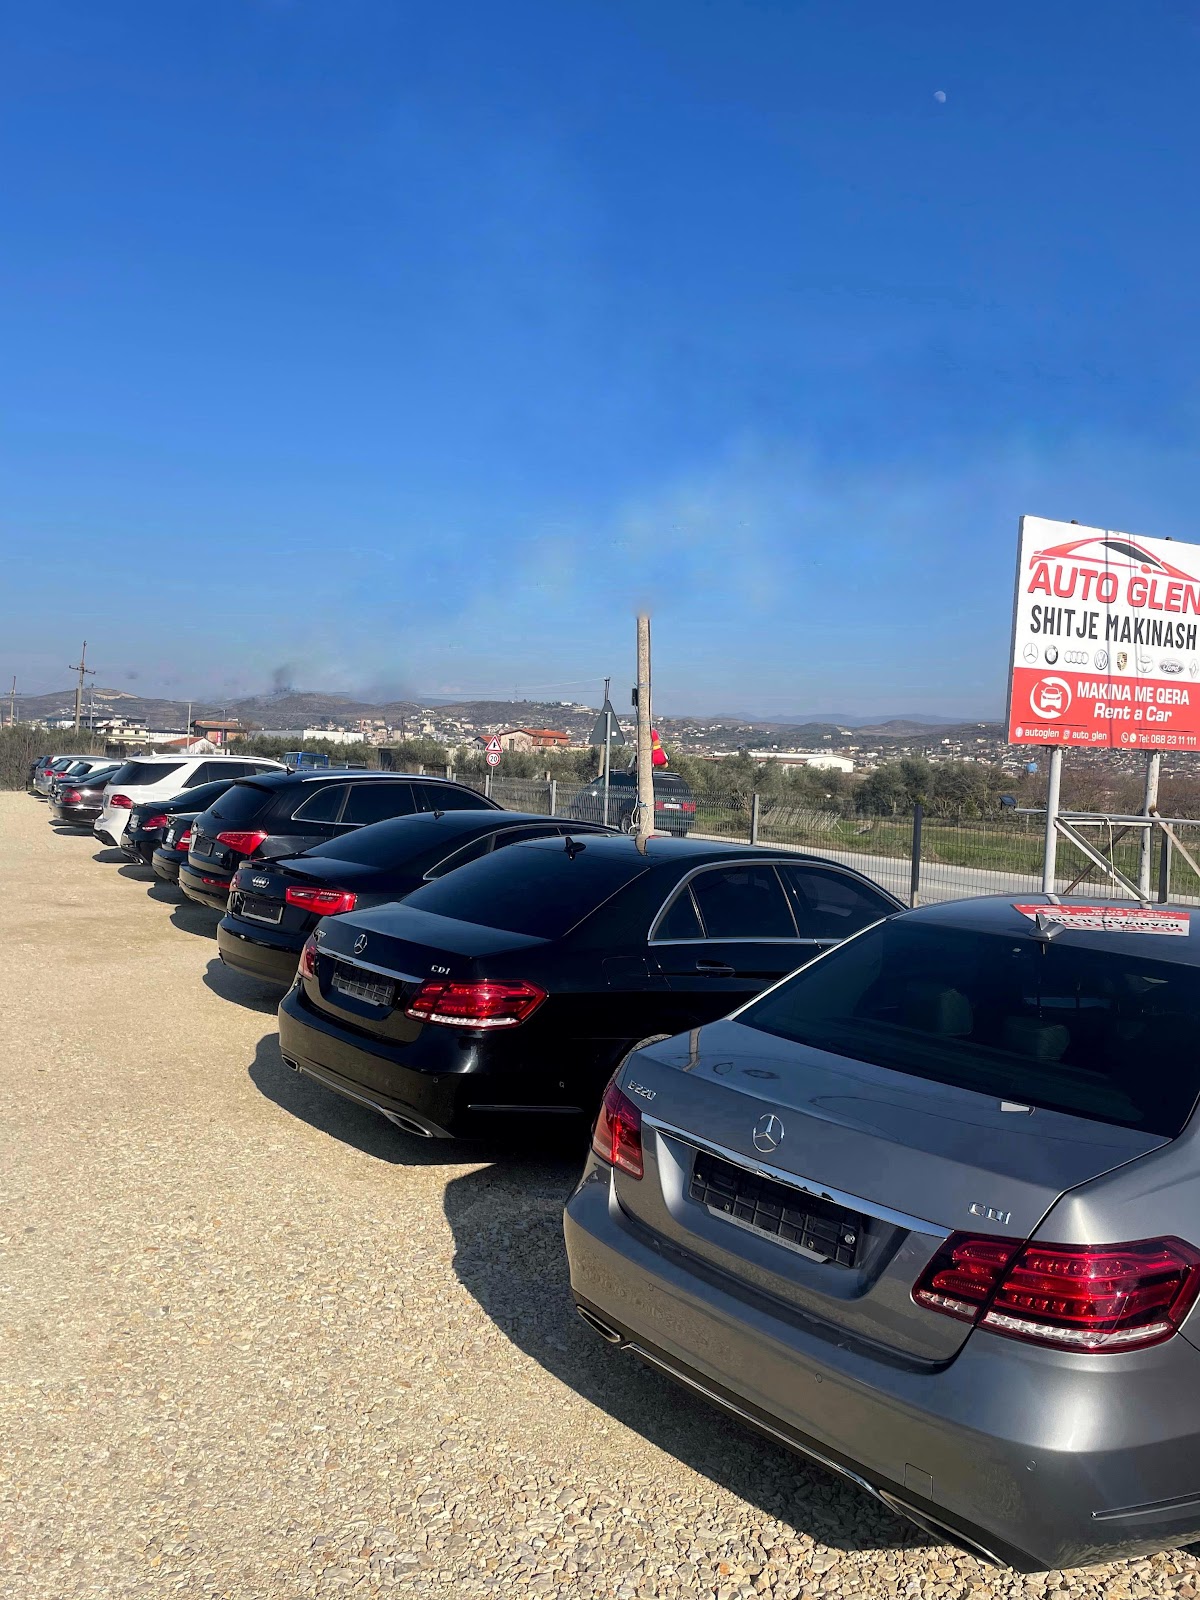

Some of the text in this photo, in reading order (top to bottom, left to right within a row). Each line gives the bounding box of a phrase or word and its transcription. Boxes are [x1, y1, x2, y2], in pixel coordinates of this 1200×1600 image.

[1027, 562, 1200, 615] AUTO GLEN
[1030, 605, 1197, 650] SHITJE MAKINASH
[1077, 681, 1190, 706] MAKINA ME QERA
[1094, 702, 1173, 722] Rent a Car
[1025, 728, 1060, 739] autoglen
[1072, 730, 1107, 742] auto_glen
[1138, 733, 1150, 743] Tel:
[1151, 734, 1166, 744] 068
[1166, 735, 1177, 745] 23
[1178, 736, 1185, 745] 11
[431, 965, 450, 975] CDI
[627, 1079, 657, 1101] E220
[968, 1201, 1011, 1225] CDI
